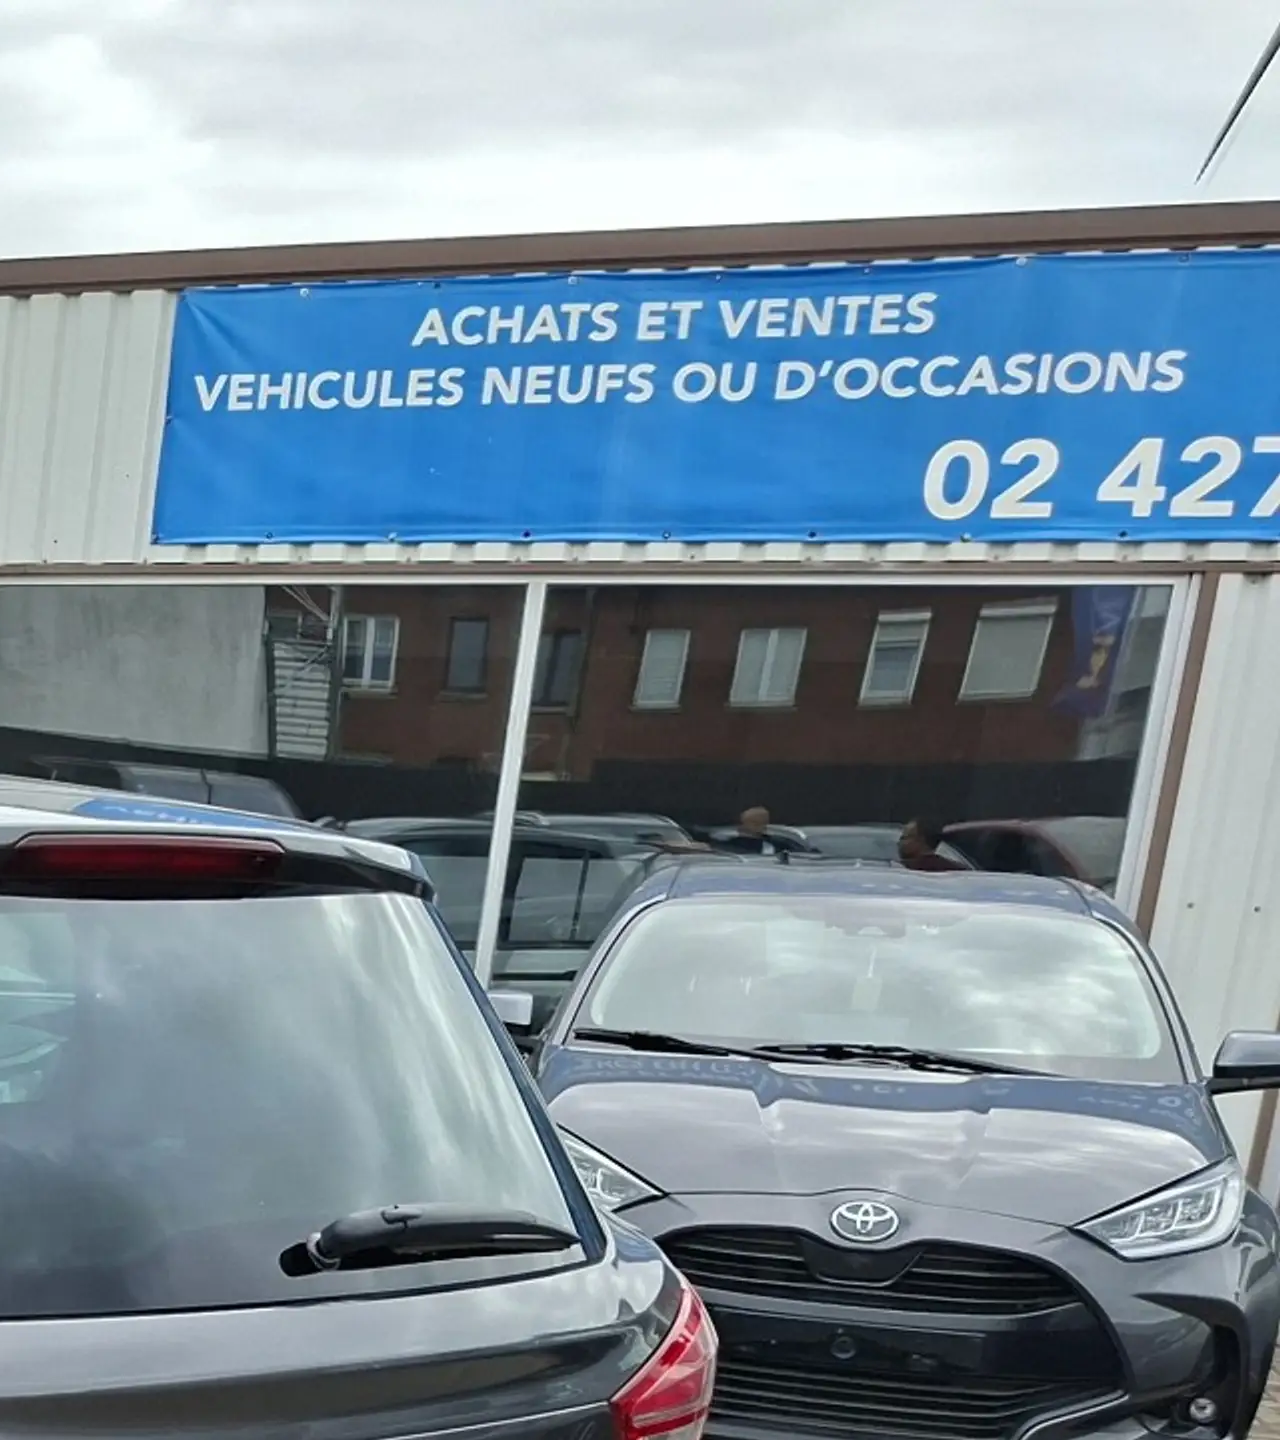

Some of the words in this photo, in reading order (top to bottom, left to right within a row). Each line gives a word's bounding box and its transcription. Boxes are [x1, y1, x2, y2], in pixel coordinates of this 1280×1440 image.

[411, 302, 619, 347] ACHATS
[636, 301, 703, 341] ET
[718, 292, 938, 339] VENTES
[194, 368, 465, 411] VEHICULES
[481, 363, 657, 406] NEUFS
[672, 361, 757, 403] OU
[774, 349, 1188, 401] D’OCCASIONS
[923, 438, 1060, 520] 02
